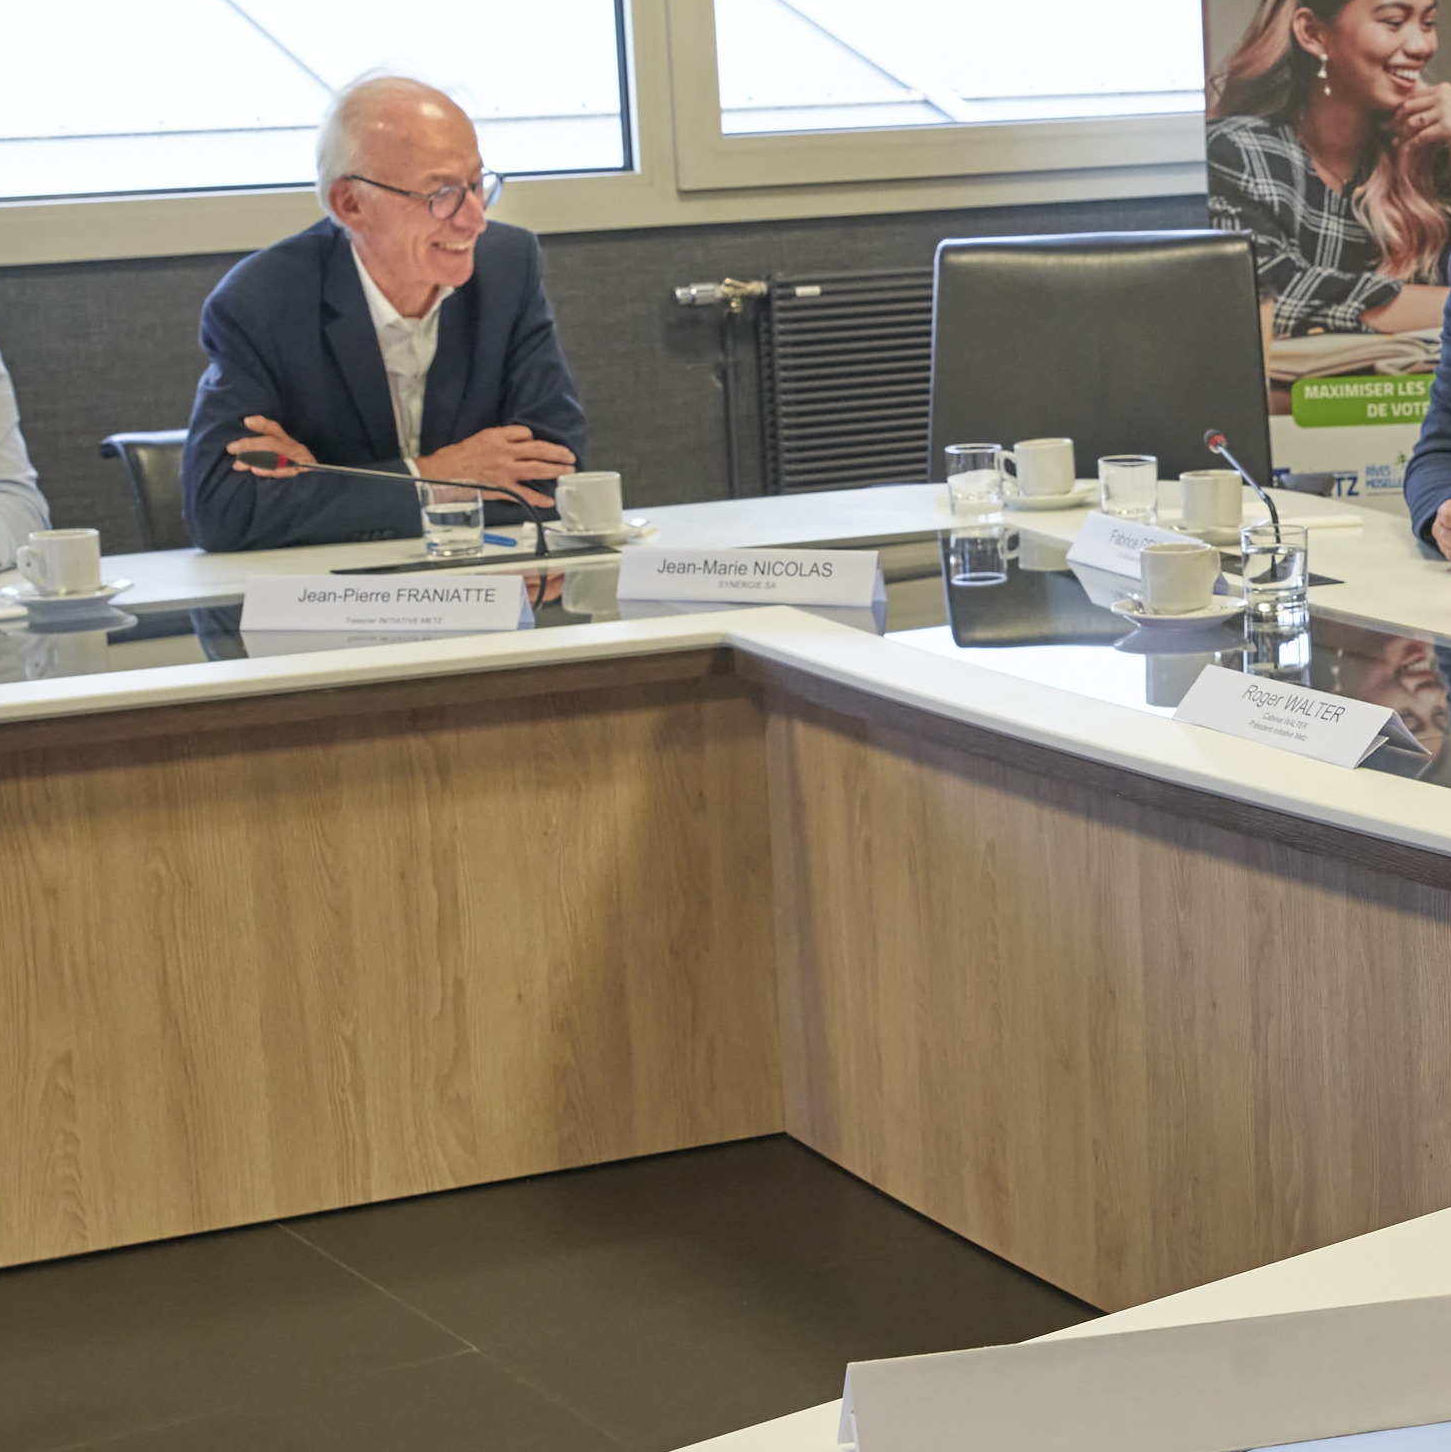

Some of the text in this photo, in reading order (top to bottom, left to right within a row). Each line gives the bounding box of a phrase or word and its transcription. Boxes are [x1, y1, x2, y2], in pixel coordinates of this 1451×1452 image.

[1304, 382, 1394, 399] MAXIMISER
[1397, 381, 1425, 397] LES
[1367, 403, 1388, 418] DE
[657, 558, 833, 577] Jean-Marie NICOLAS
[298, 587, 496, 604] Jean-Pierre FRANIATTE
[1242, 684, 1346, 723] Roger WALTER
